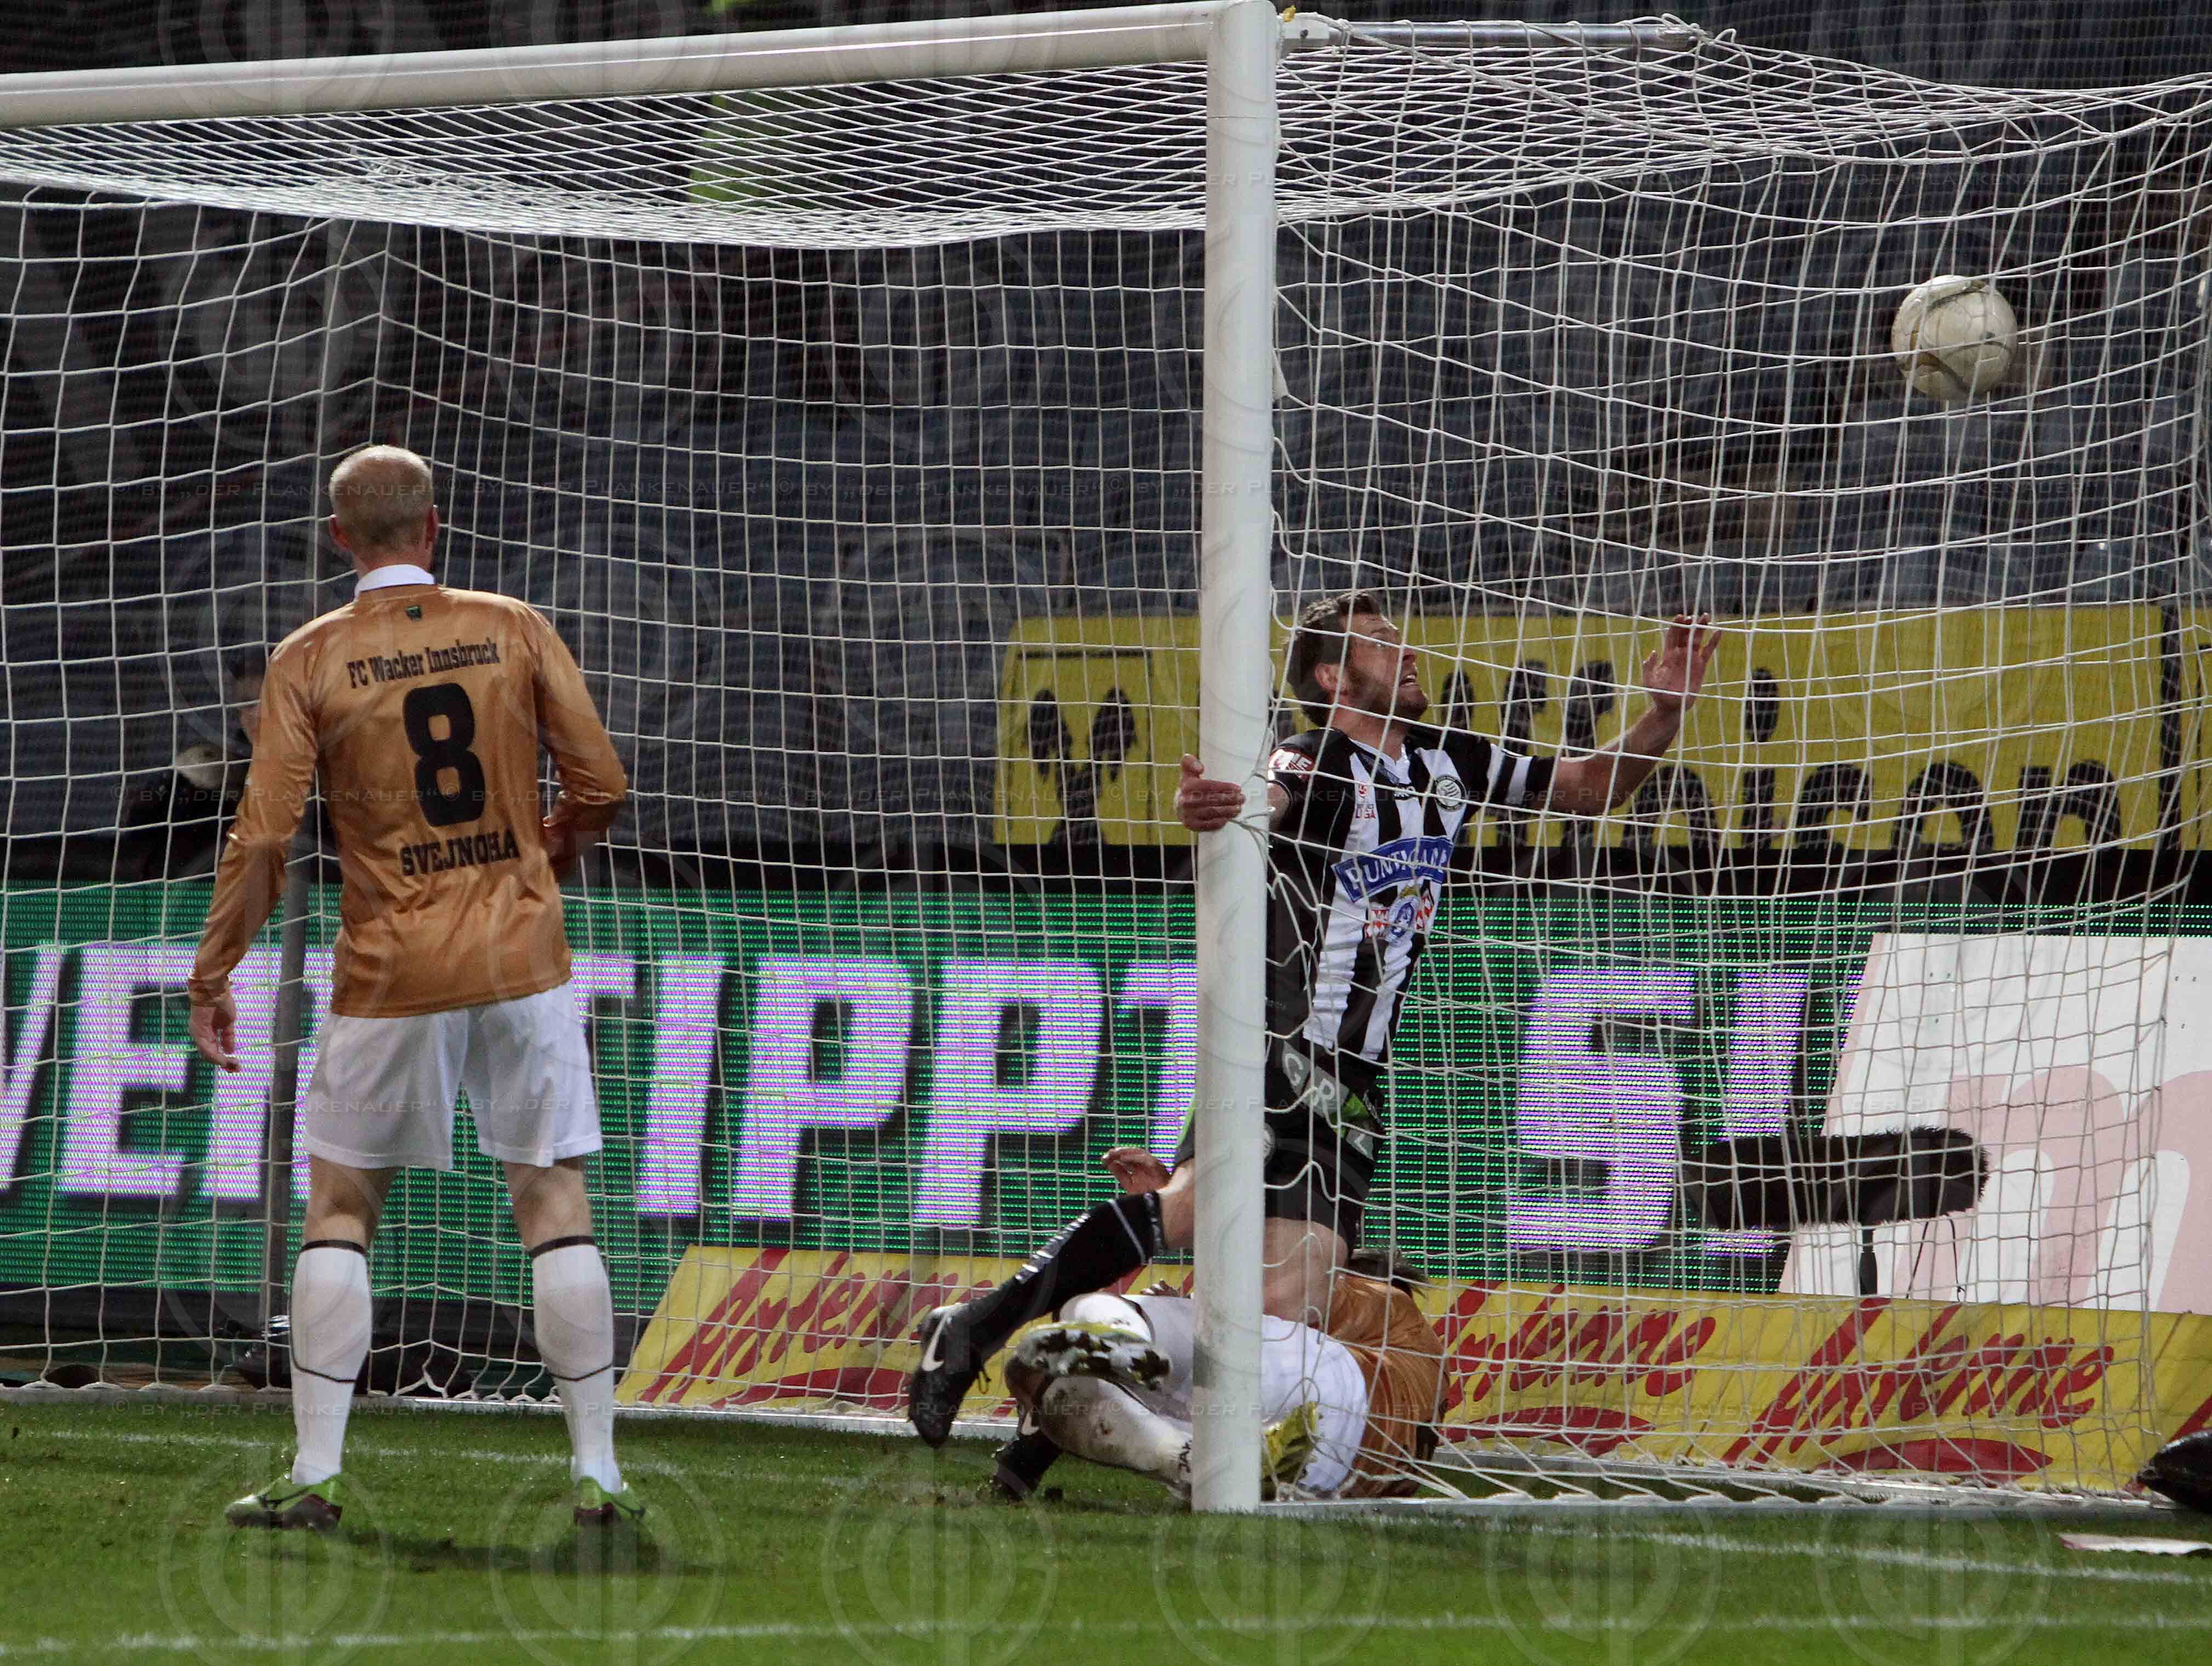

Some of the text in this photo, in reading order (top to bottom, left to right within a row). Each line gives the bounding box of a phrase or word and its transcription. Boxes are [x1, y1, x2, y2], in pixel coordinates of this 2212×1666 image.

[347, 636, 500, 688] FC Wacker Innsbruck
[403, 682, 485, 827] 8
[400, 826, 520, 876] SVEJNOHA
